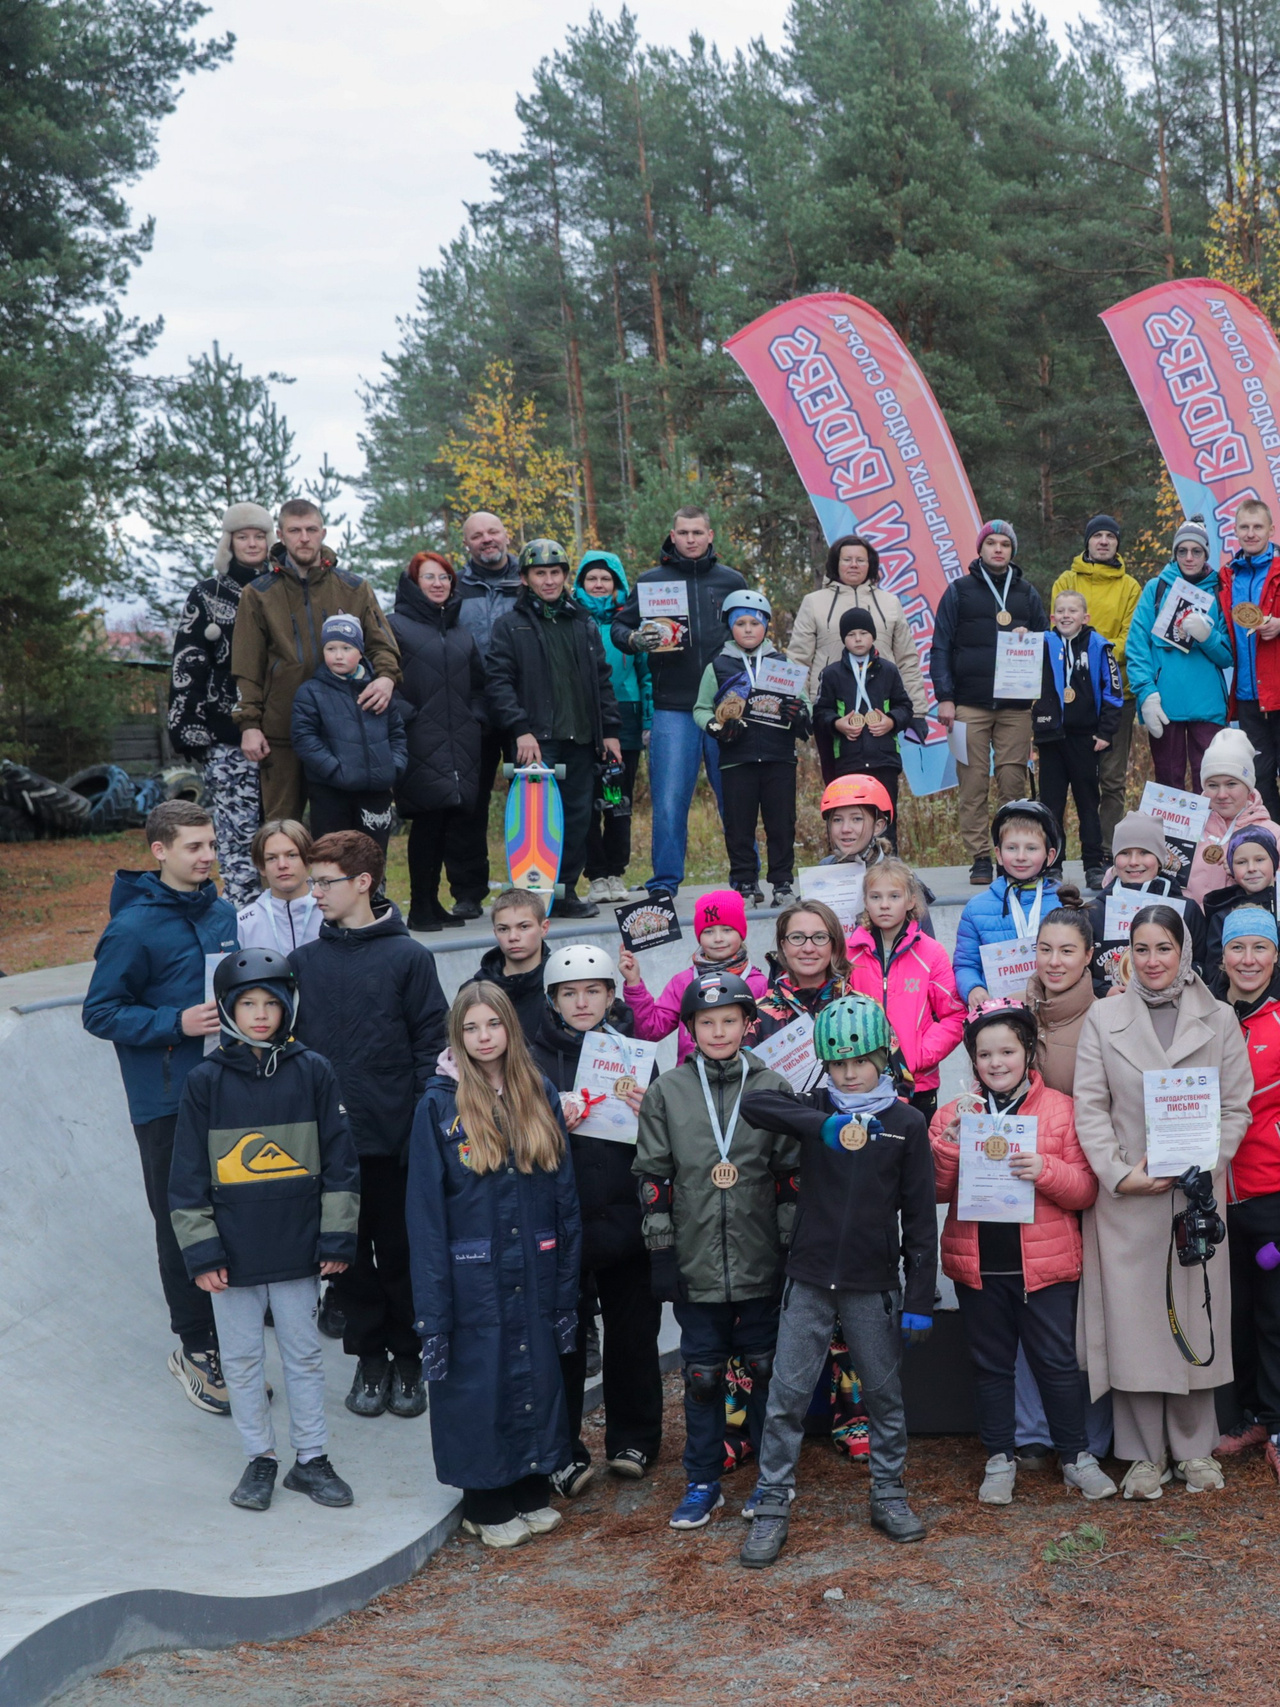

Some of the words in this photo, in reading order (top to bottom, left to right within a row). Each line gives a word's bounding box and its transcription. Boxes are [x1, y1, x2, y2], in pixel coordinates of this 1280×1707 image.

[648, 598, 678, 607] ГРАМОТА
[1006, 649, 1035, 657] ГРАМОТА
[766, 675, 795, 687] ГРАМОТА
[1151, 807, 1191, 826] ГРАМОТА
[239, 910, 255, 921] UFC
[621, 905, 663, 933] СЕРТИФИКАТ
[782, 1050, 811, 1072] ПИСЬМО
[592, 1058, 637, 1076] ГРАМОА
[1155, 1093, 1211, 1103] БЛАГОДАРСТВЕННОЕ
[1167, 1102, 1200, 1112] ПИСЬМО
